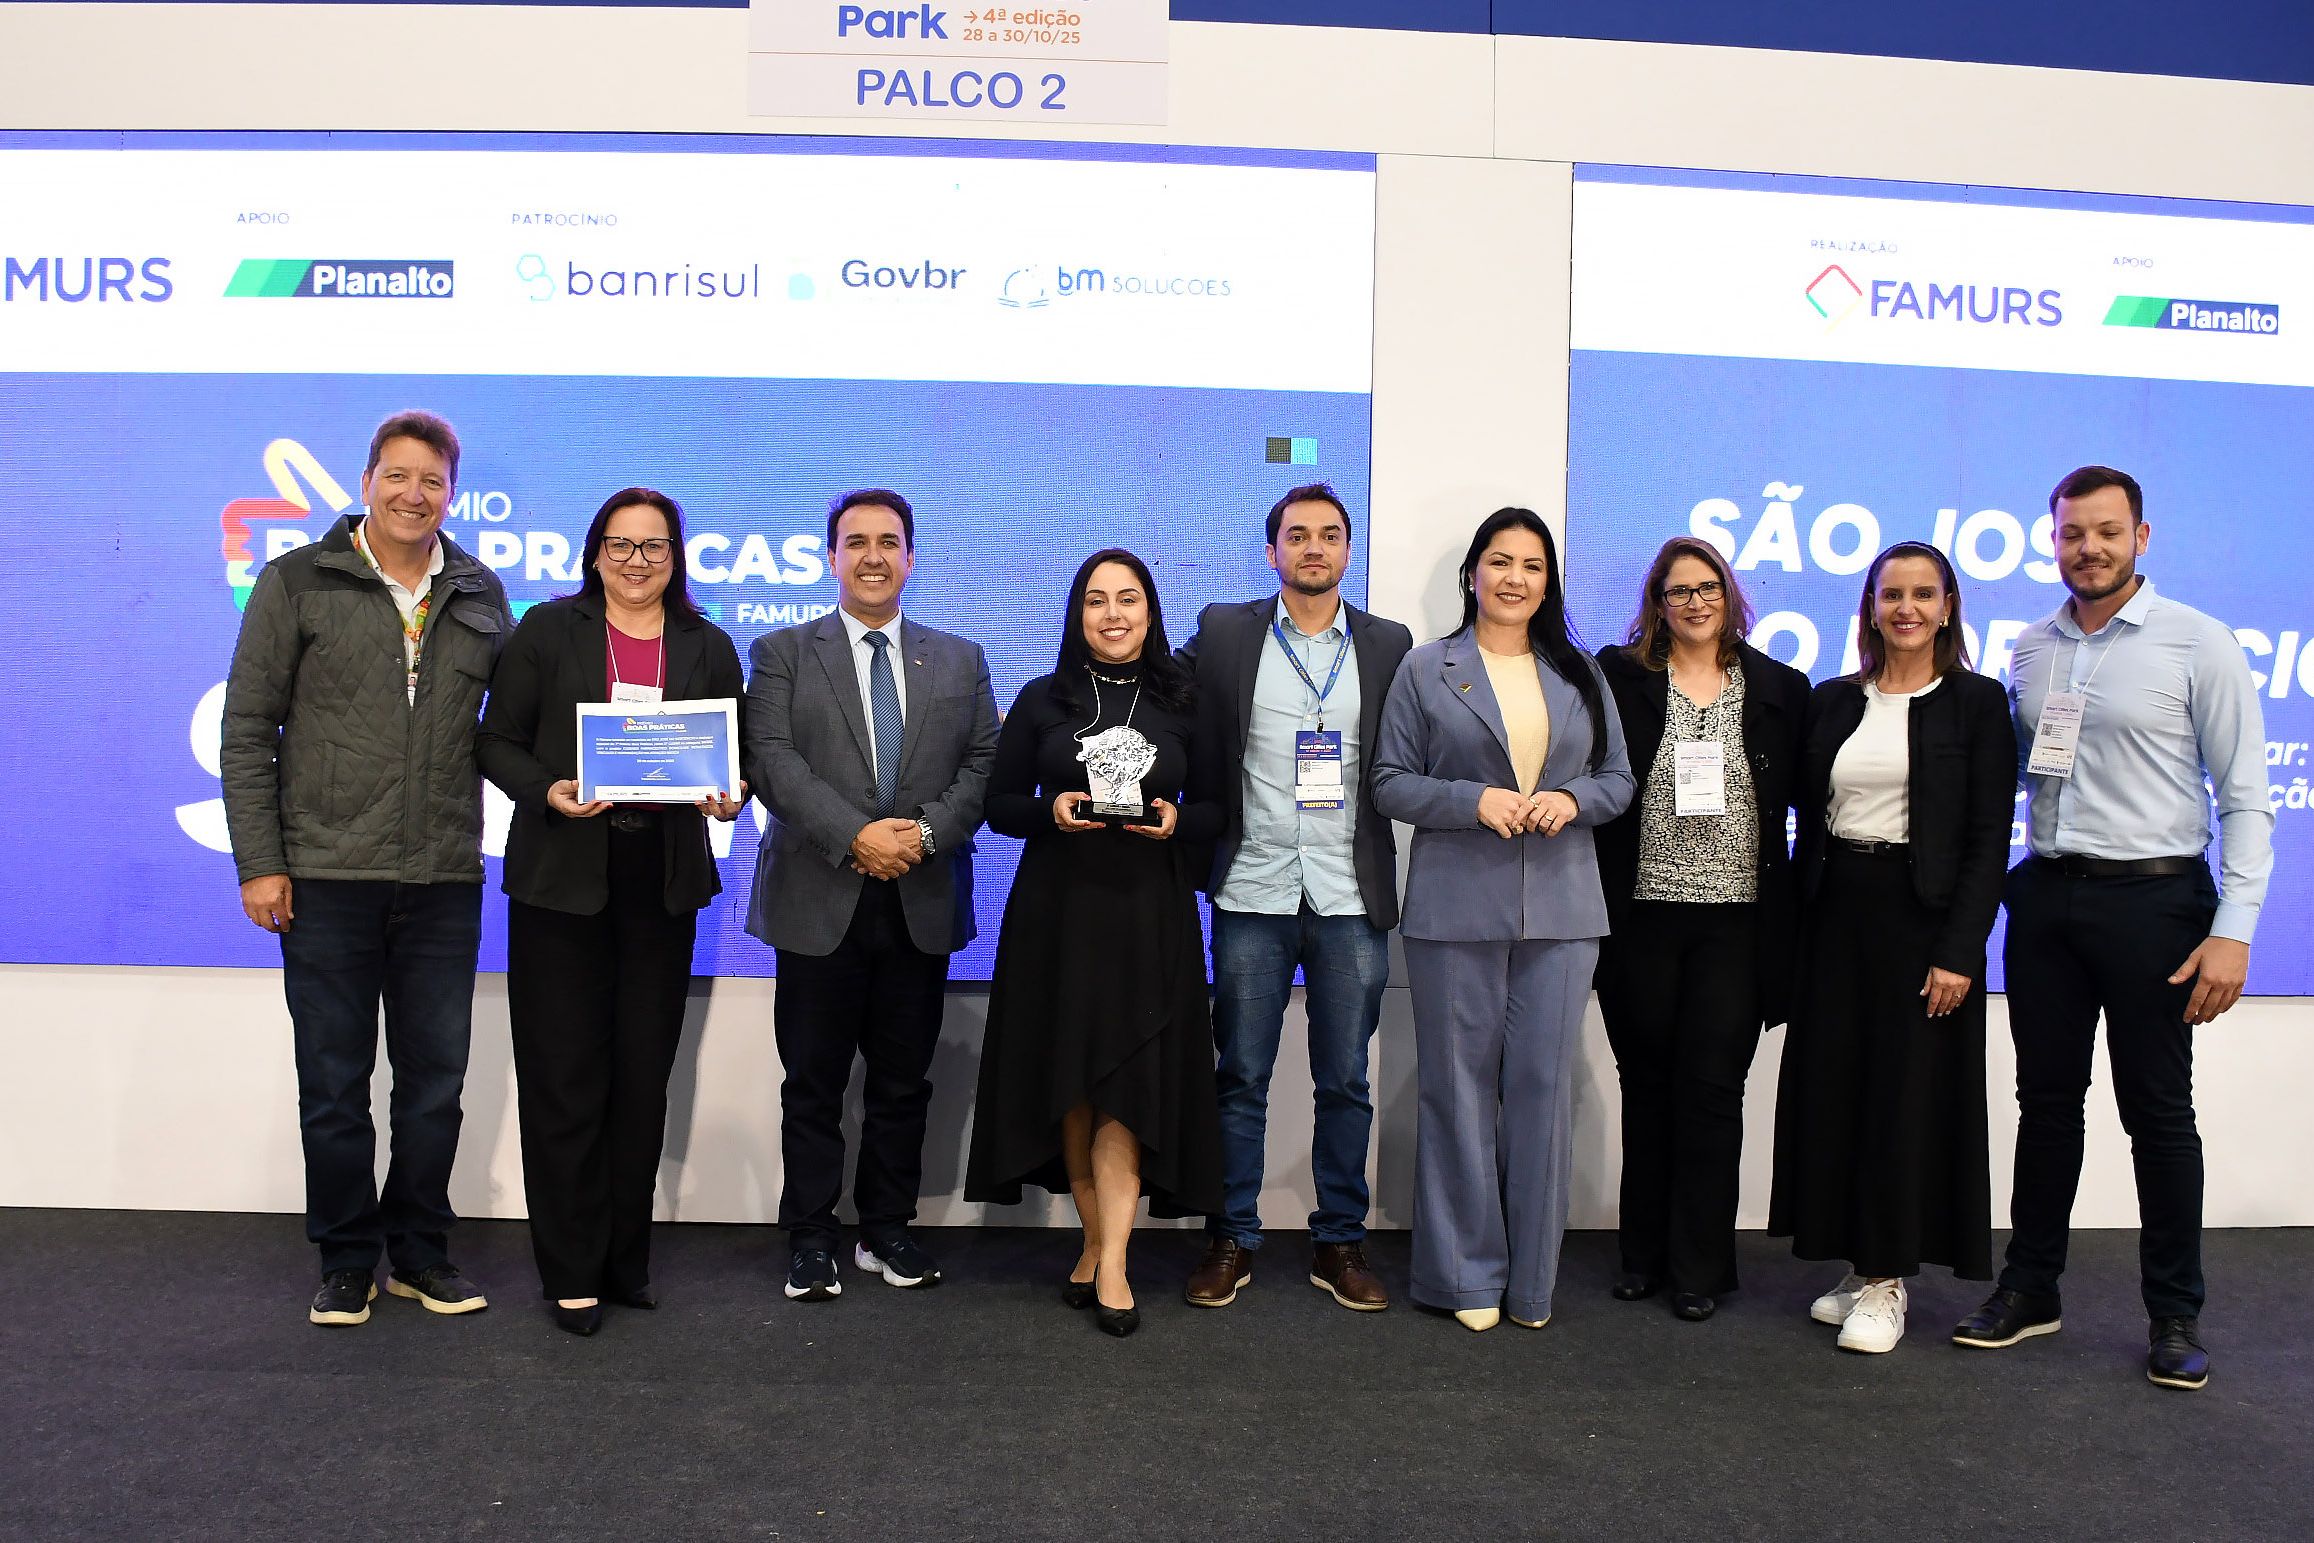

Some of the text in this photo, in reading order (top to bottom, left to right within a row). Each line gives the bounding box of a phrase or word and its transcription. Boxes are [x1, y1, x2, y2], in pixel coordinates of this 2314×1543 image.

[838, 4, 949, 39] Park
[983, 8, 1081, 28] 4ª edição
[963, 28, 1081, 45] 28 a 30/10/25
[857, 69, 1066, 110] PALCO 2
[237, 212, 290, 225] APOIO
[841, 259, 967, 290] Govbr
[2112, 256, 2154, 269] APOIO
[5, 257, 173, 302] MURS
[313, 265, 452, 296] Planalto
[568, 261, 758, 297] banrisul
[1057, 266, 1105, 292] bm
[1870, 280, 2063, 327] FAMURS
[2170, 301, 2278, 333] Planalto
[1688, 481, 1881, 576] SÃO
